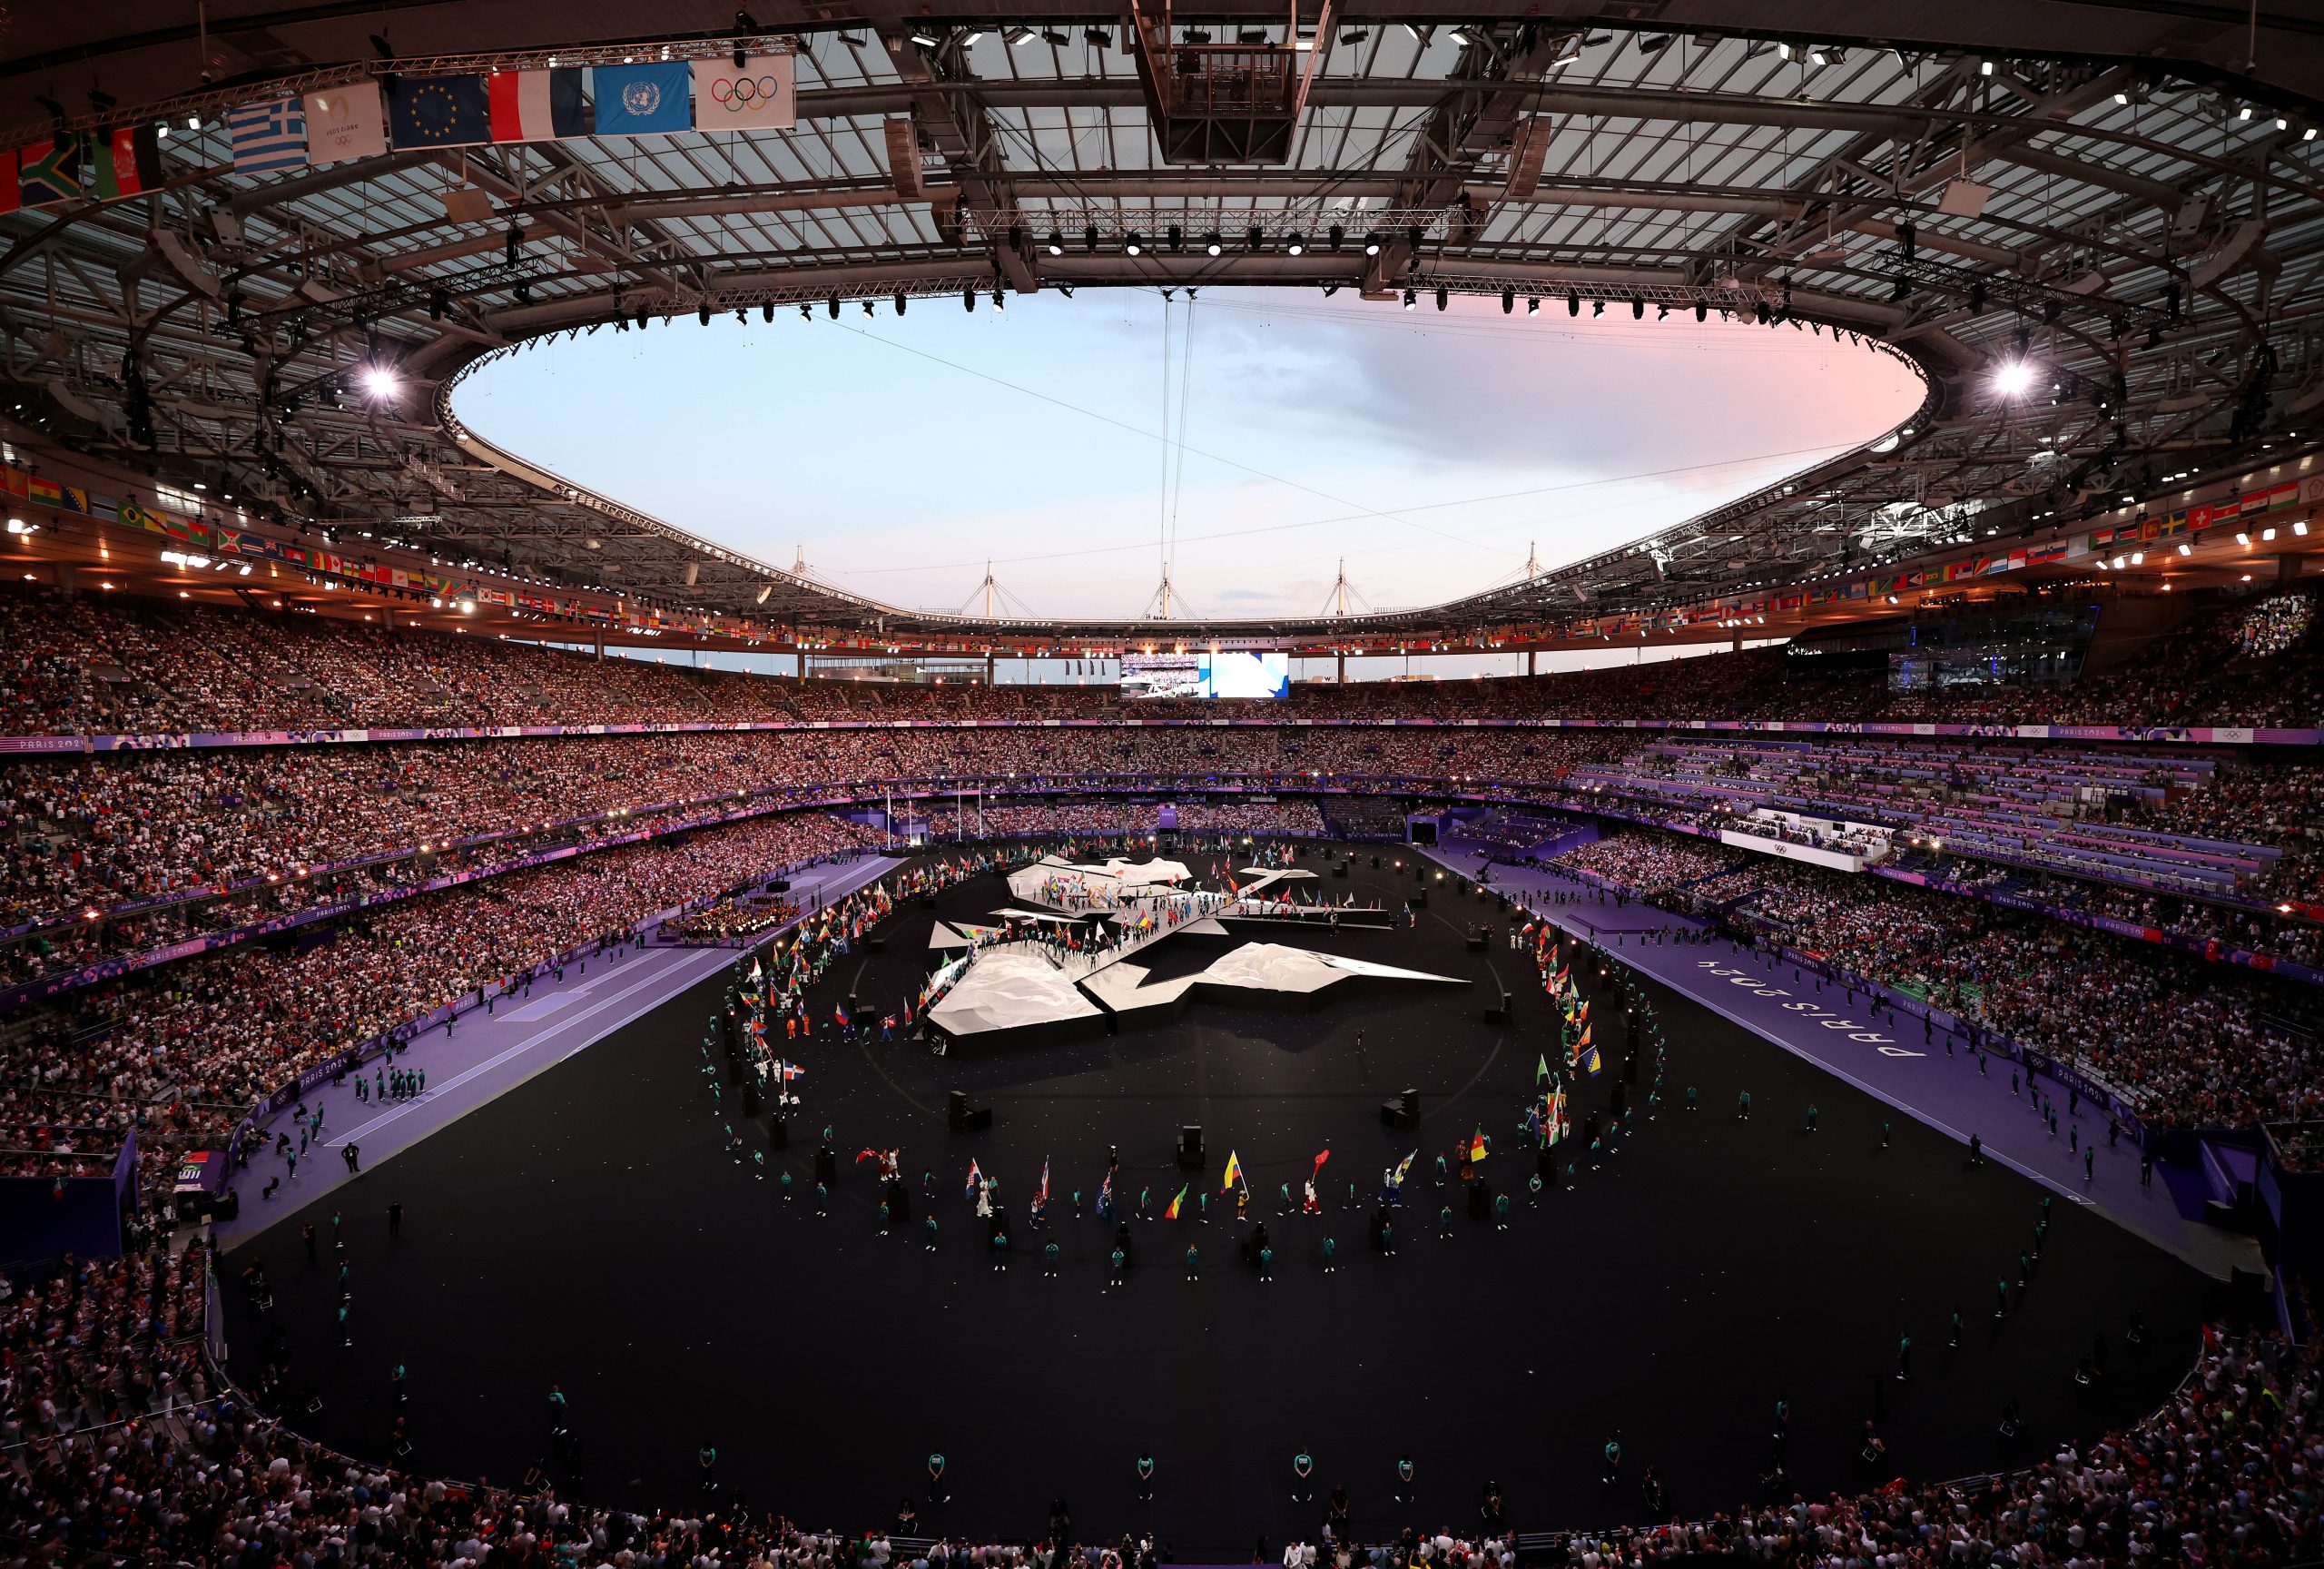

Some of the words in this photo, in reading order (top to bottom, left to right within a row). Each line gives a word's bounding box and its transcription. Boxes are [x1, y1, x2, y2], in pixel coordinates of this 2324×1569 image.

[20, 740, 54, 749] PARIS
[1998, 895, 2016, 905] PARIS
[2018, 900, 2034, 909] 2024
[316, 908, 334, 918] PARIS
[335, 904, 350, 913] 2024
[2105, 922, 2128, 933] PARIS
[172, 945, 193, 956] 2024
[591, 940, 601, 950] 202
[1787, 952, 1803, 963] PARIS
[1804, 958, 1818, 969] 2024
[1698, 961, 1792, 997] 2024
[455, 997, 474, 1011] PARIS
[1903, 1000, 1923, 1014] PARIS
[1782, 1002, 1927, 1058] PARIS
[300, 1069, 323, 1089] PARIS
[325, 1057, 348, 1074] 2024
[2058, 1069, 2082, 1089] PARIS
[2083, 1085, 2103, 1103] 2024
